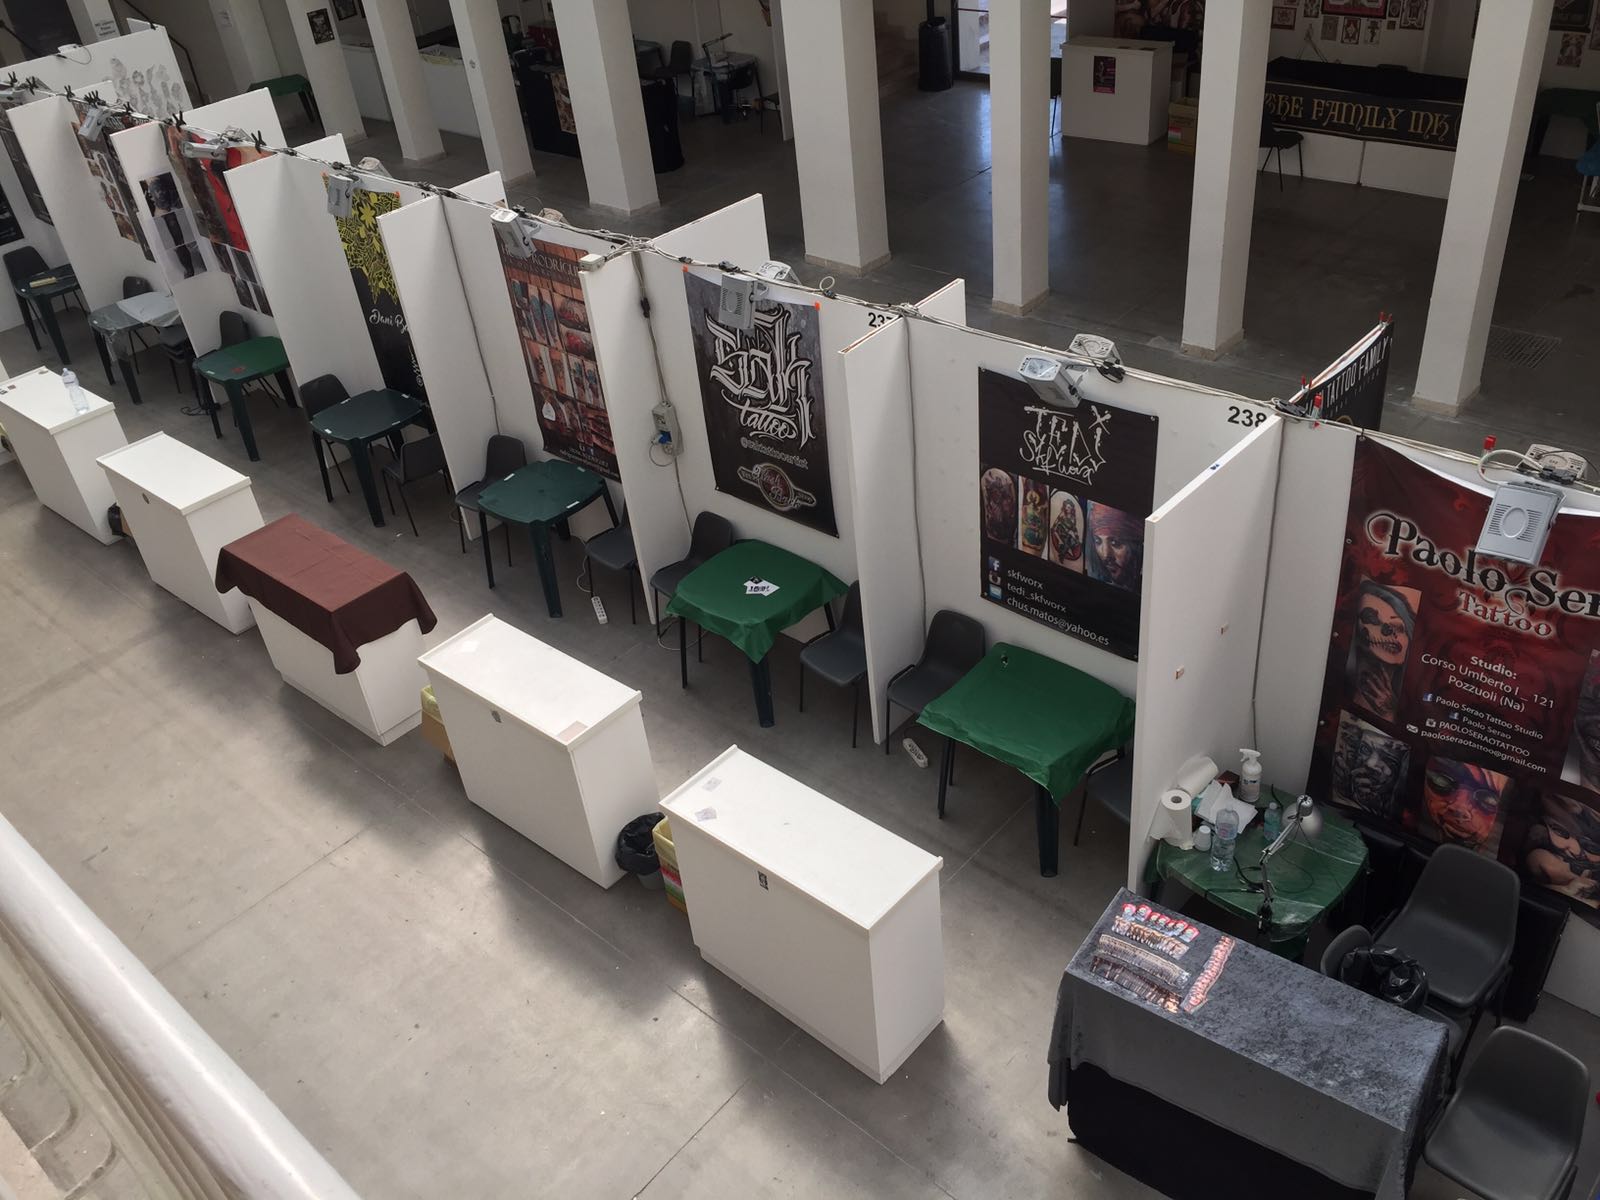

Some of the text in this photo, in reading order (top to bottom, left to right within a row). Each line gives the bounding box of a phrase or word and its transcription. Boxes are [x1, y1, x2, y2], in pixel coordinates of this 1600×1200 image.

[1311, 98, 1406, 132] FAMILY
[1407, 110, 1451, 140] INK
[1326, 363, 1358, 409] TATTOO
[1358, 335, 1389, 381] FAMILY
[720, 389, 798, 441] tattoo
[1366, 513, 1506, 593] Paolo
[1007, 567, 1044, 589] skfworx
[1007, 582, 1067, 613] tedi_skfworx
[1007, 596, 1110, 646] chus.matos@yahoo.es
[1459, 592, 1553, 638] Tattoo
[1421, 653, 1456, 671] Corso
[1459, 664, 1512, 693] Umberto
[1533, 694, 1554, 709] 121
[1470, 656, 1517, 680] Studio:
[1448, 675, 1525, 713] Pozzuoli (Na)
[1435, 696, 1543, 740] Paolo Serao Tattoo Studio
[1439, 721, 1530, 757] PAOLOSERAOTATTOO
[1462, 716, 1512, 740] Paolo Serao
[1421, 730, 1546, 773] paoloseraotattoo@gmail.com
